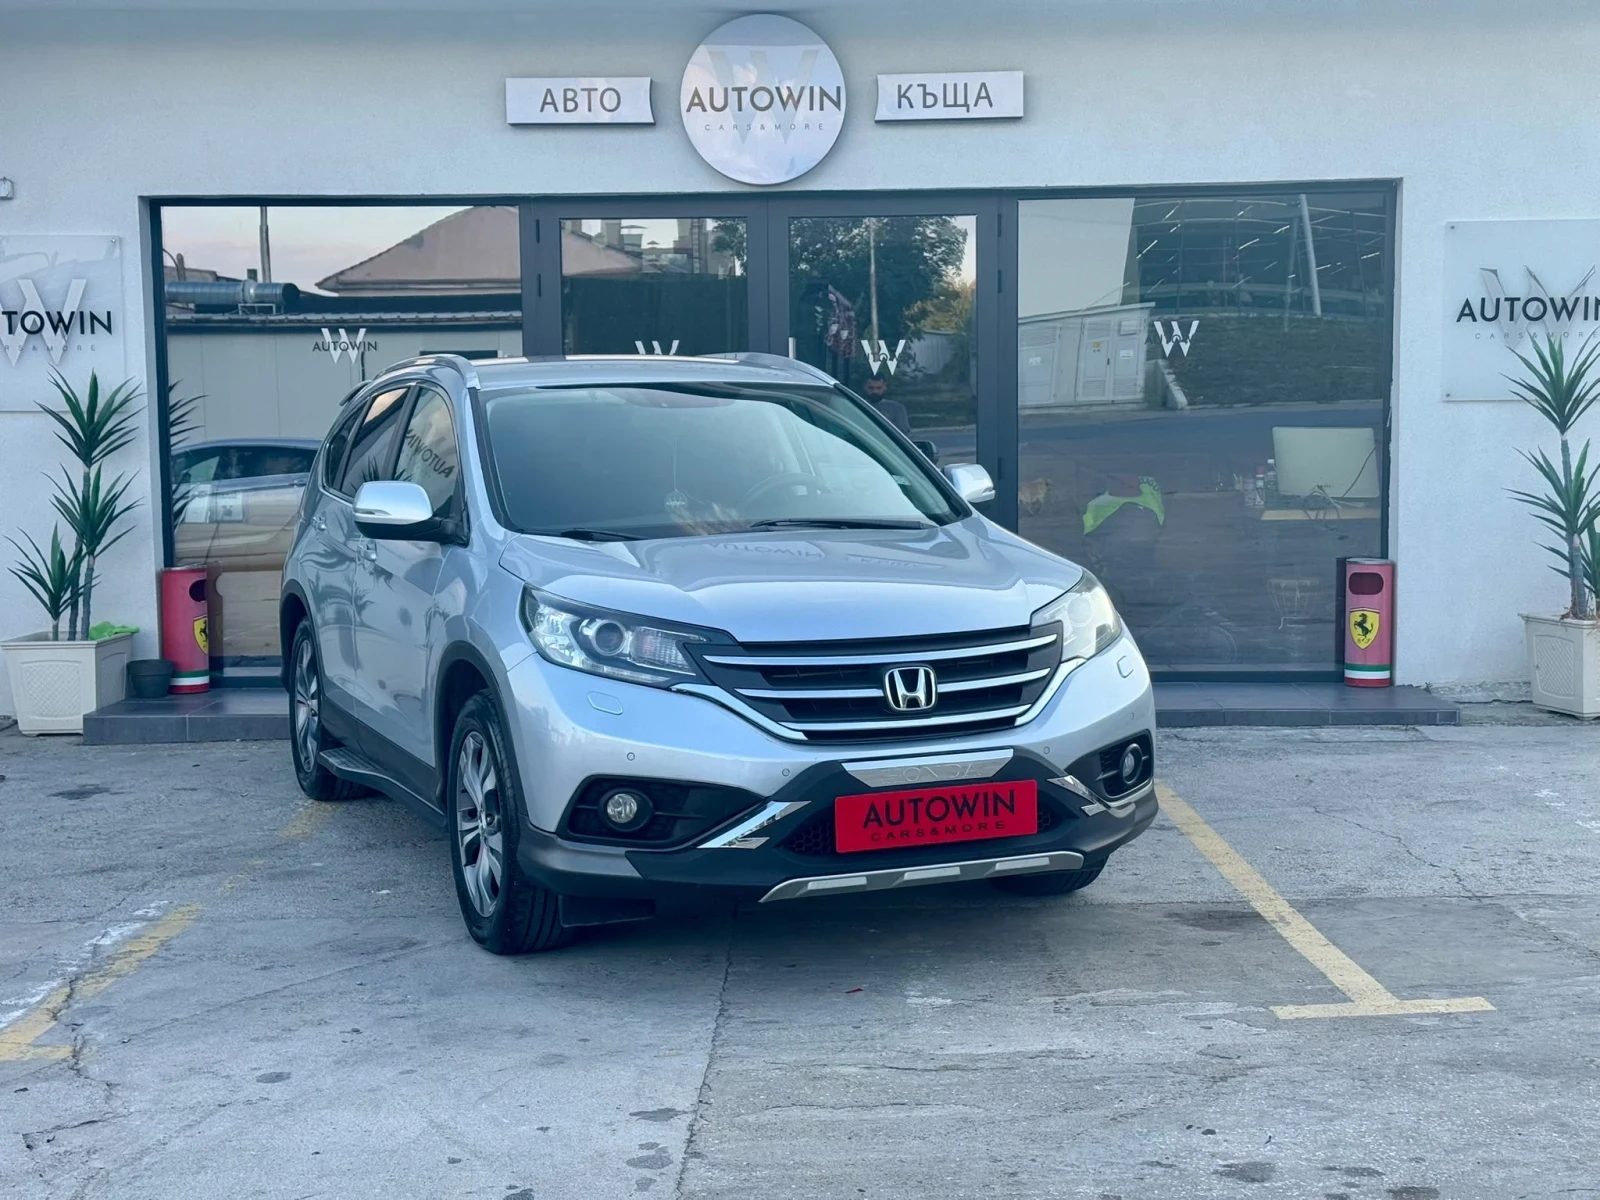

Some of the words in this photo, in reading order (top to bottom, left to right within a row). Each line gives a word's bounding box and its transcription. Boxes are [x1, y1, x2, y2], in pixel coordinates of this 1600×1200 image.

[539, 87, 622, 113] АВТО
[686, 85, 842, 113] AUTOWIN
[897, 81, 993, 113] КЪЩА
[704, 122, 824, 131] CARS&MORE
[1456, 296, 1600, 323] AUTOWI
[1, 310, 113, 336] TOWIN
[312, 340, 378, 352] AUTOWIN
[862, 789, 1016, 829] AUTOWIN
[870, 820, 1005, 842] CARS&MORE
